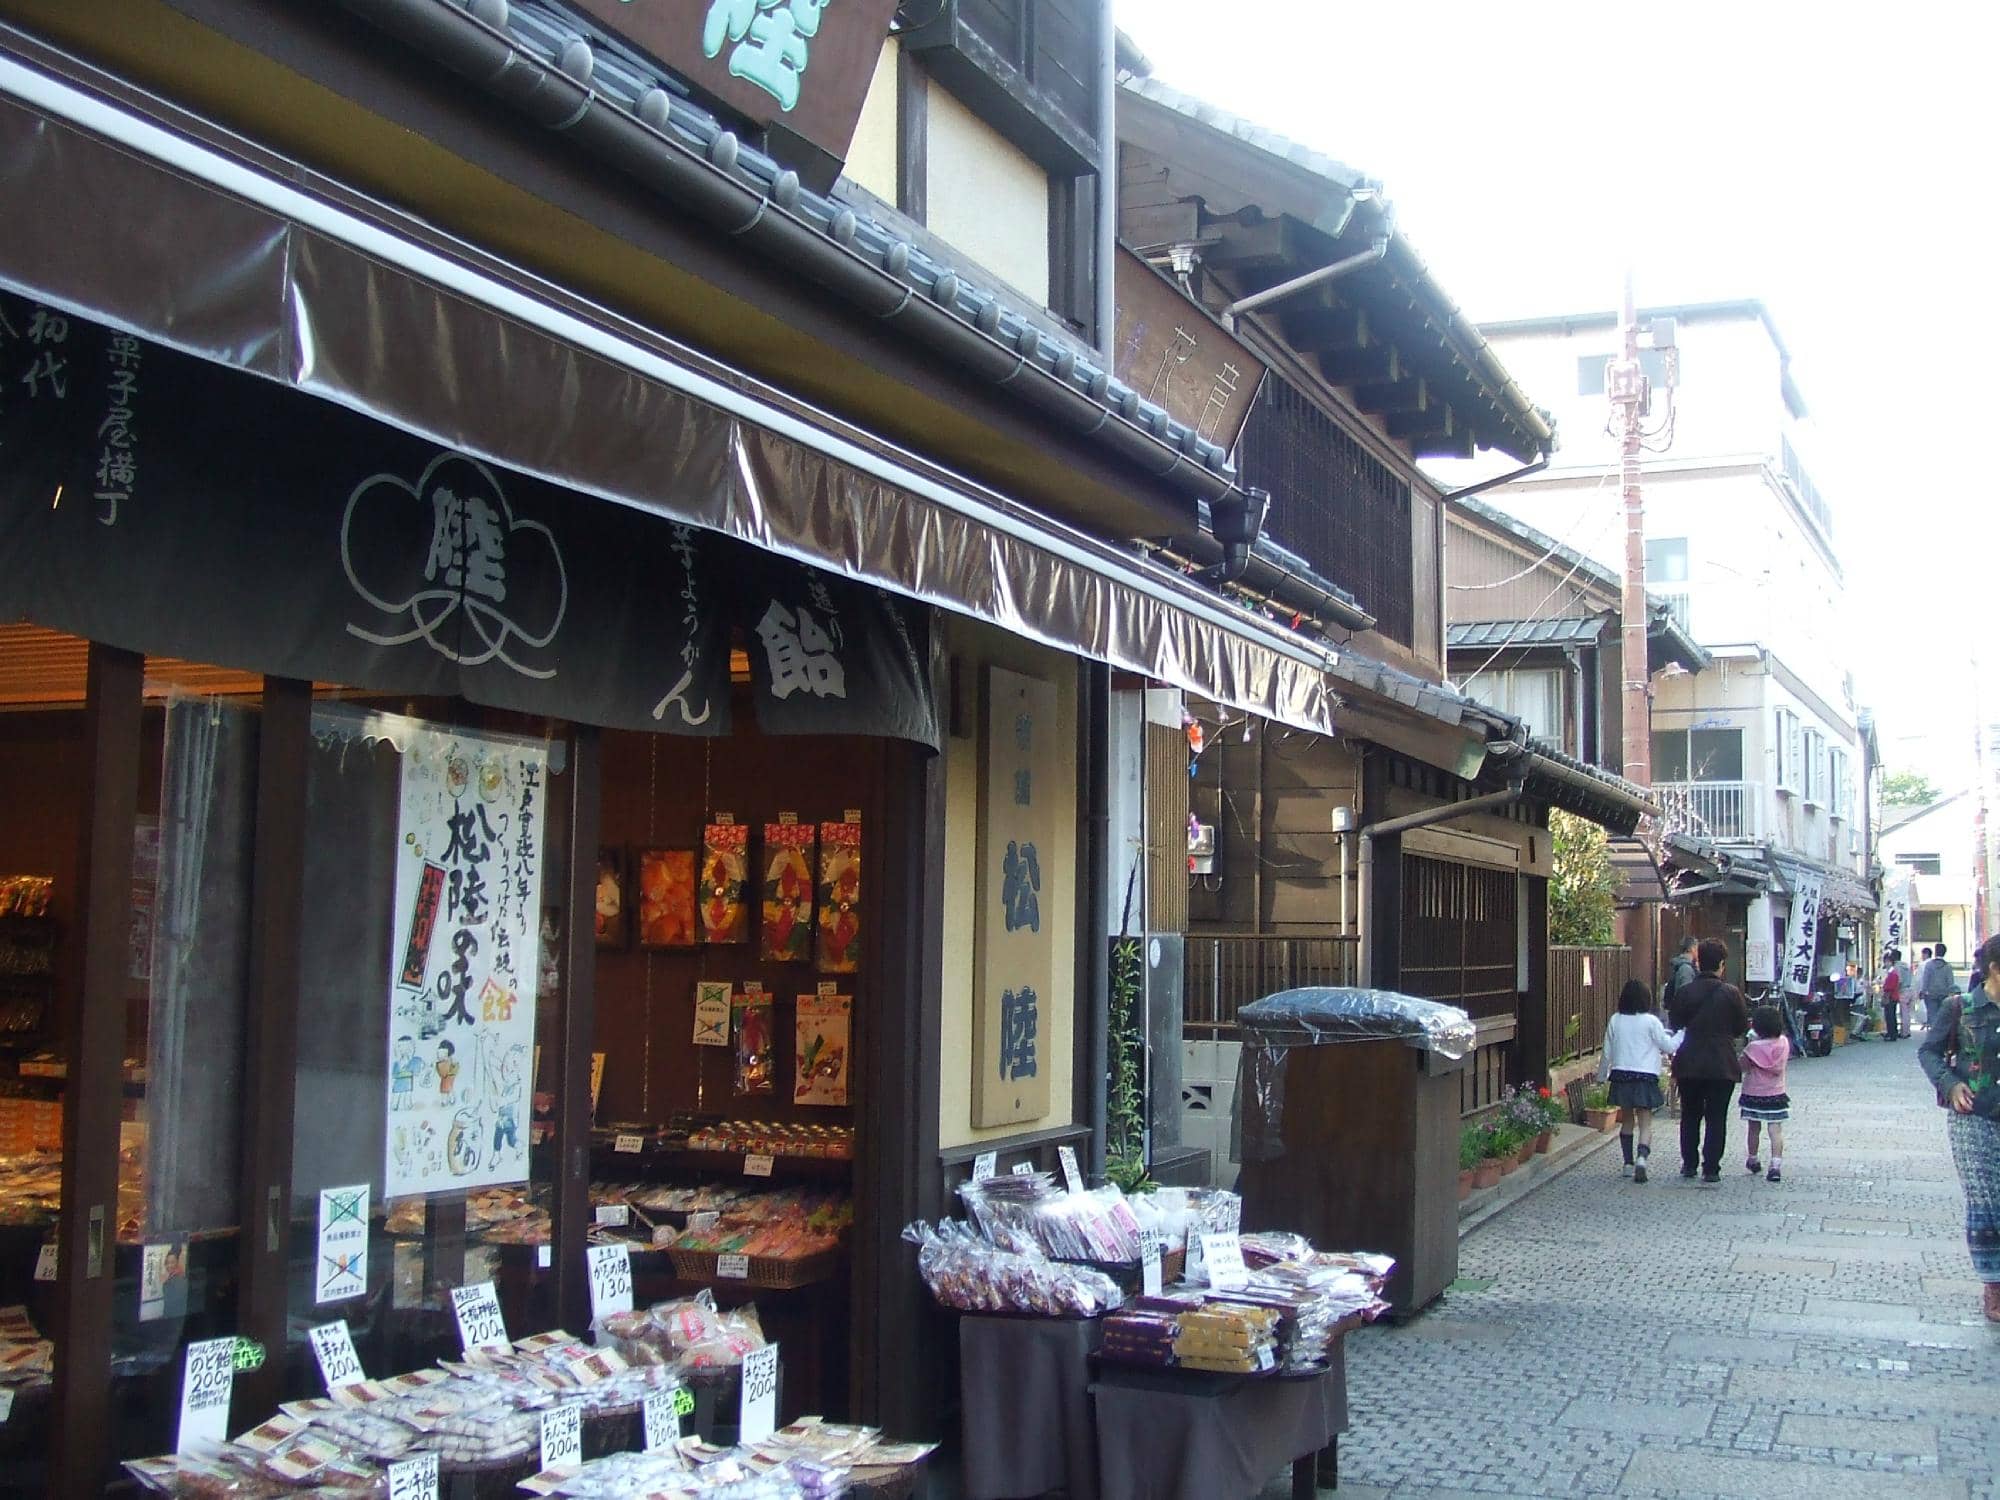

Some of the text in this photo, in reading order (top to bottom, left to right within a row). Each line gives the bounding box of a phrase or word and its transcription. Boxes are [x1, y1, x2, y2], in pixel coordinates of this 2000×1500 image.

[93, 328, 142, 526] 菓子屋横丁
[436, 799, 497, 1026] 松陸の味
[1791, 899, 1814, 985] いも大福
[191, 1352, 231, 1373] のど飴
[192, 1370, 231, 1393] 200円
[547, 1437, 579, 1462] 200円
